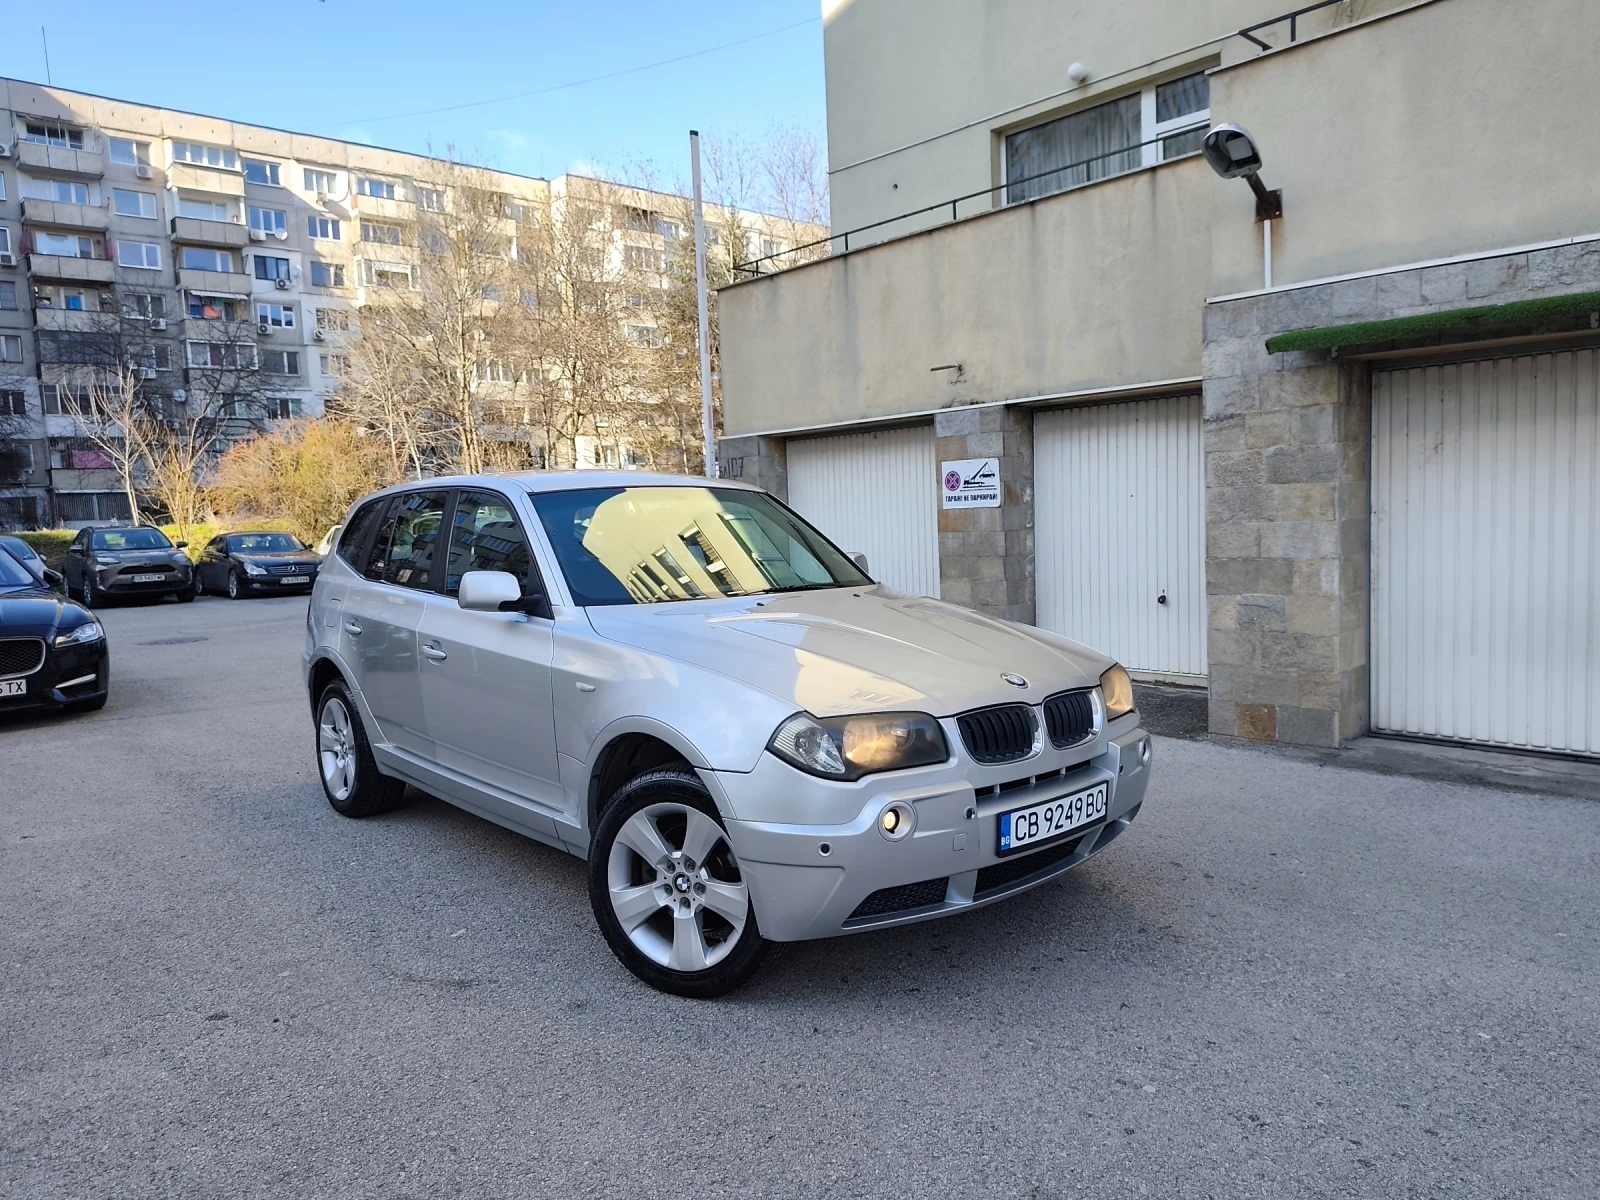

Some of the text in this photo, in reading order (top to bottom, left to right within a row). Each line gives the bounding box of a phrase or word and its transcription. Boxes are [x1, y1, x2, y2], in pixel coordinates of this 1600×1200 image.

[1015, 789, 1104, 841] CB 9249 BO
[1001, 835, 1010, 845] BG
